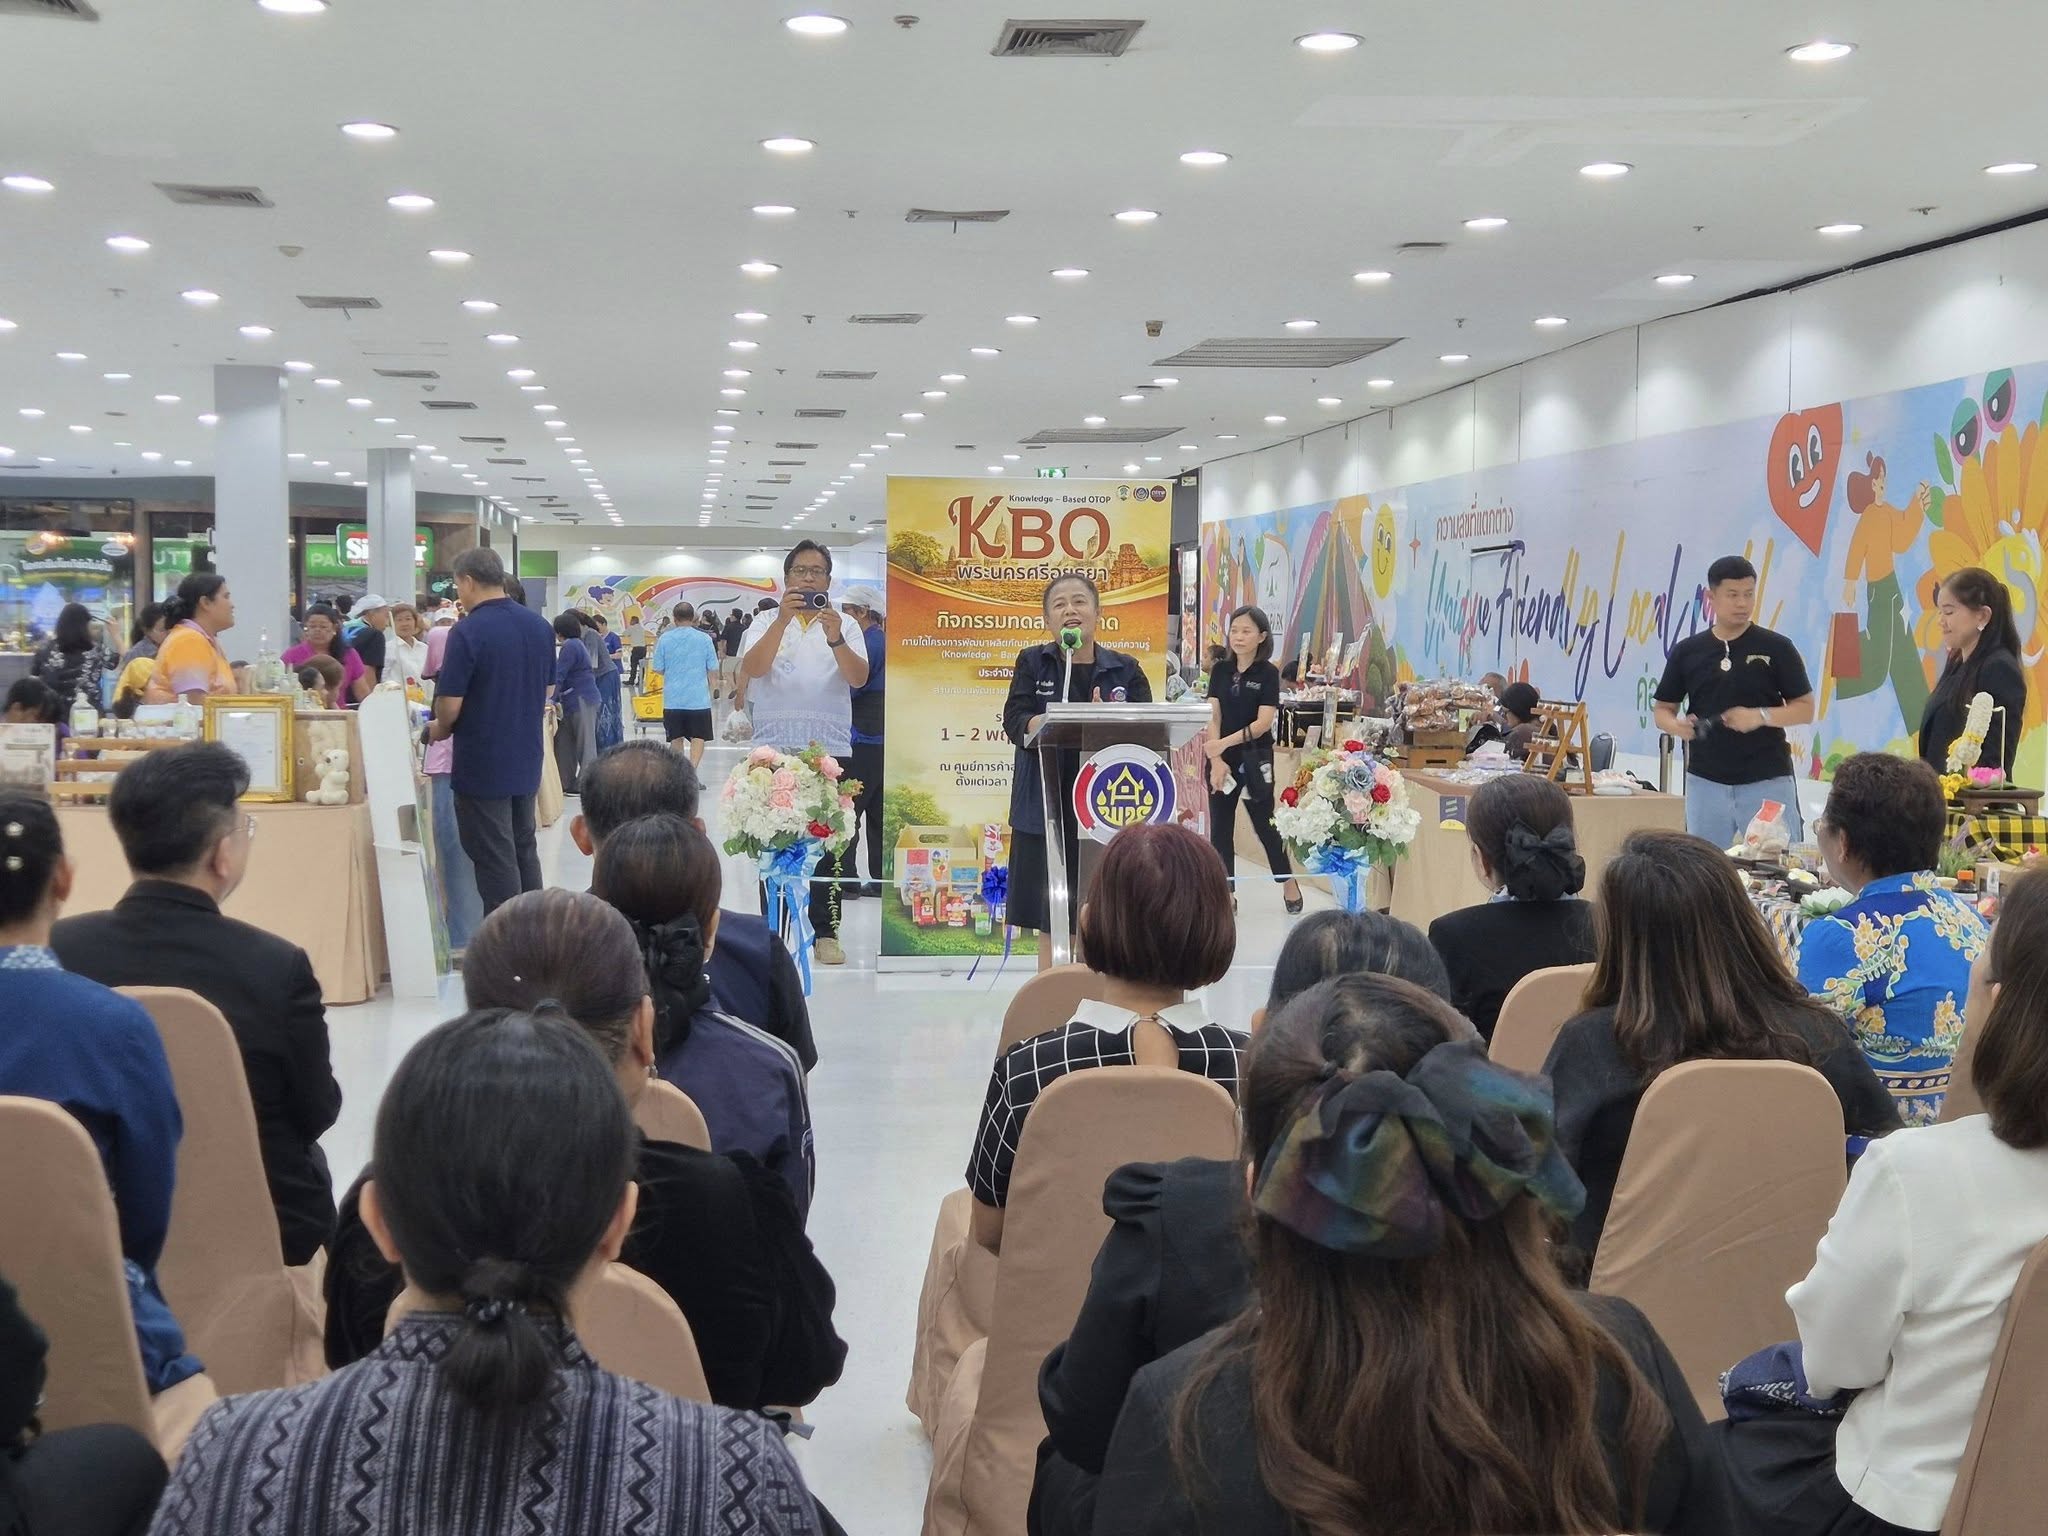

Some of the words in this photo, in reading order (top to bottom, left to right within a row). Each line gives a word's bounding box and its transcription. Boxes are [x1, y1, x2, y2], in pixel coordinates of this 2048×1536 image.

[1008, 494, 1053, 504] Knowledge
[1062, 495, 1086, 504] Based
[1088, 495, 1112, 504] OTOP
[948, 495, 1111, 560] KBO
[1436, 492, 1514, 550] ความสุขที่แตกต่าง
[310, 553, 335, 567] PA
[958, 564, 1108, 581] พระนครศรีอยธยา
[1424, 549, 1492, 676] Unique
[1495, 539, 1601, 701] Friendly
[1603, 529, 1690, 679] Local
[978, 670, 1014, 679] ประจำปีง
[941, 728, 950, 741] 1
[970, 728, 980, 741] 2
